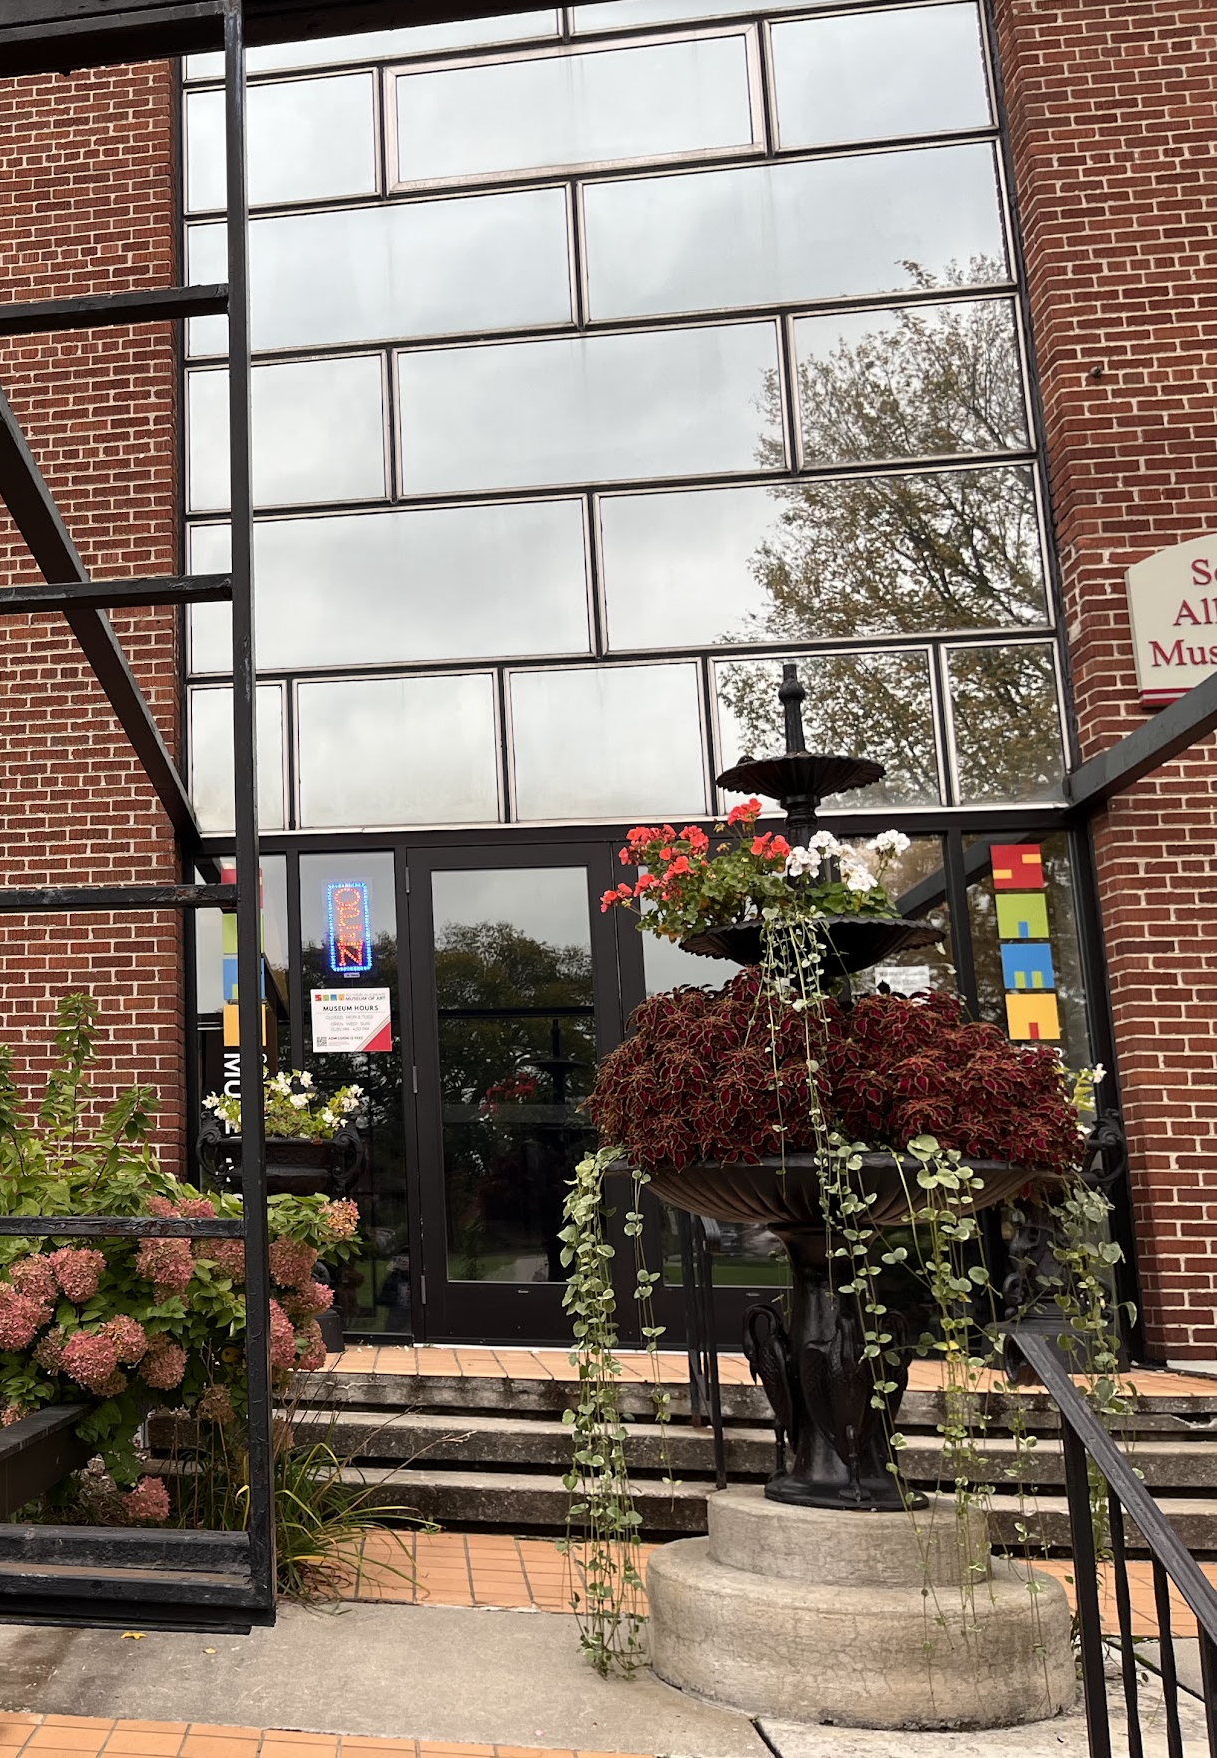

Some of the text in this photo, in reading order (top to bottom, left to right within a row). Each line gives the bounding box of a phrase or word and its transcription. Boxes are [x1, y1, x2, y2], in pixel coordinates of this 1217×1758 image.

[1191, 558, 1217, 585] S
[1149, 639, 1217, 667] Mus
[334, 888, 363, 966] OPEN
